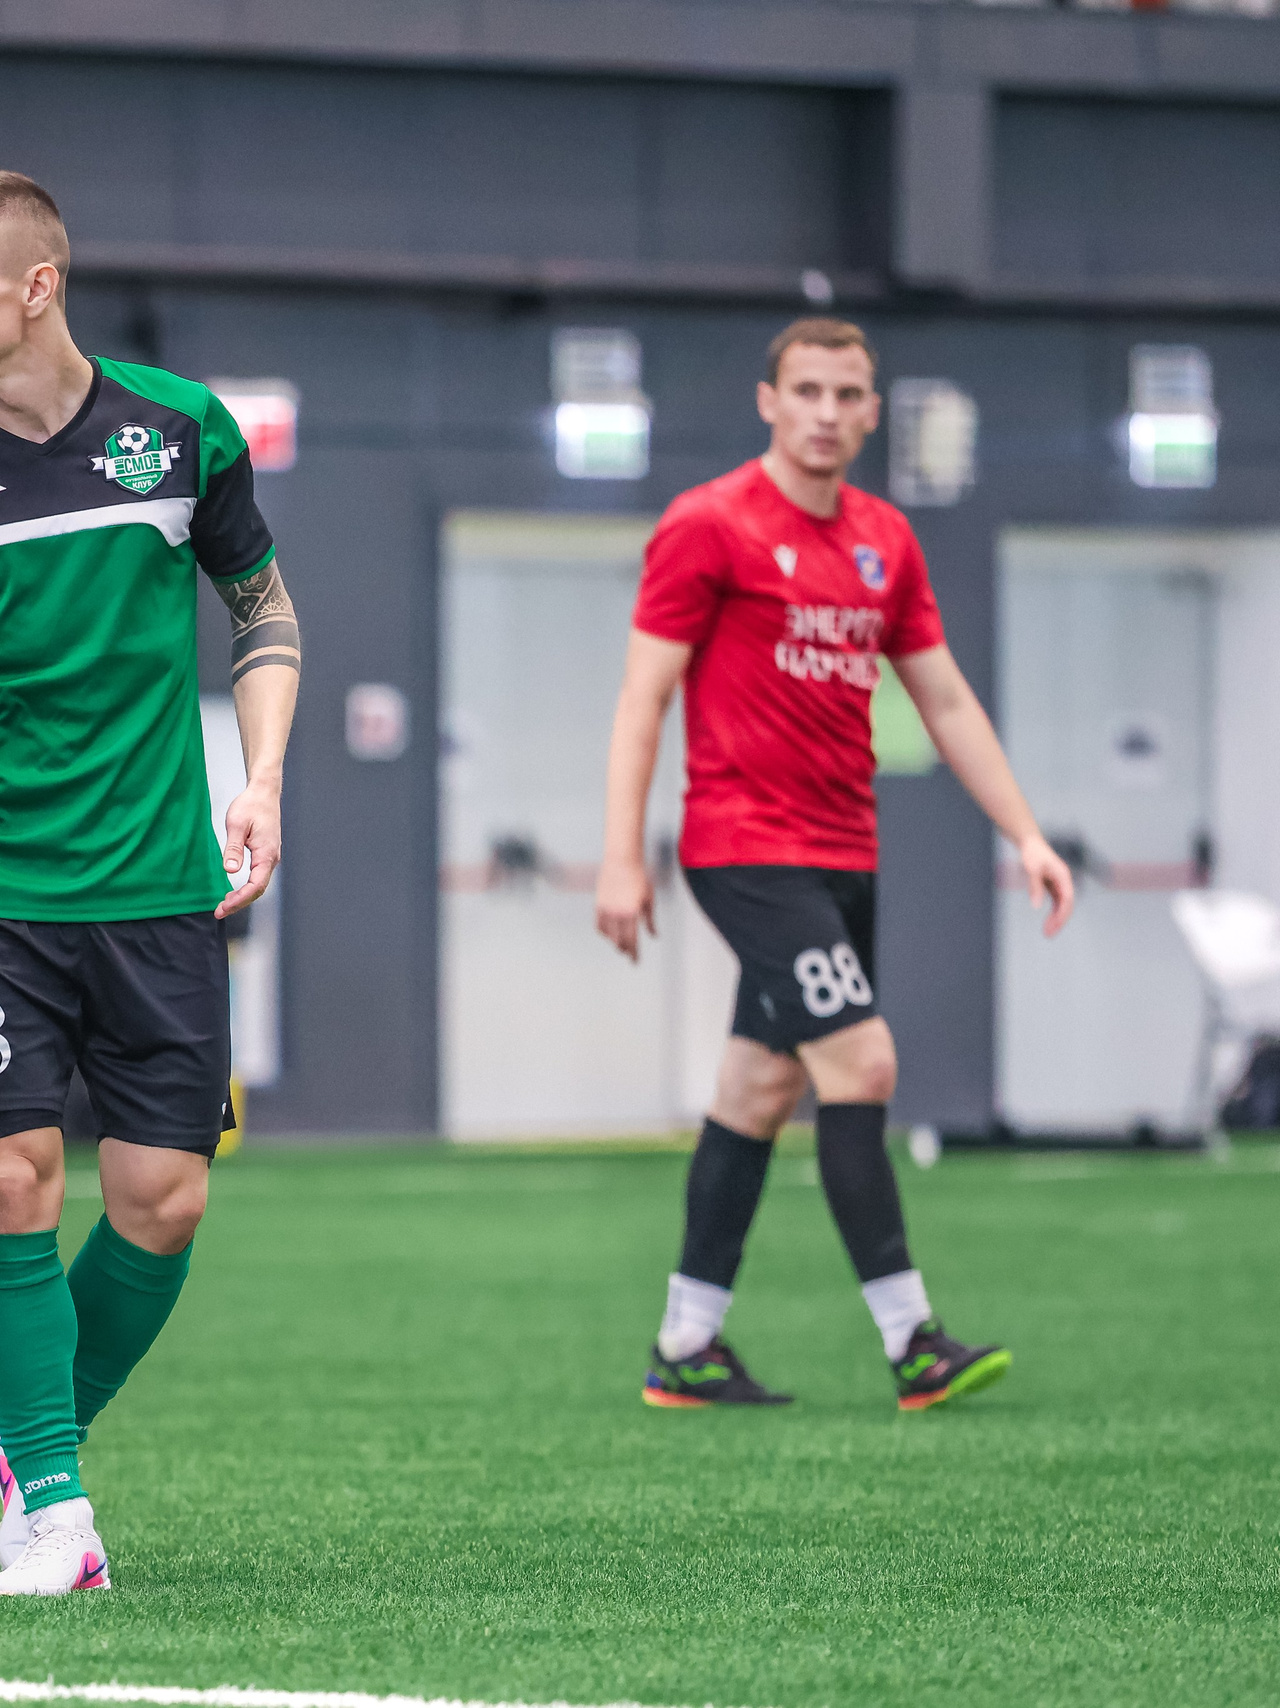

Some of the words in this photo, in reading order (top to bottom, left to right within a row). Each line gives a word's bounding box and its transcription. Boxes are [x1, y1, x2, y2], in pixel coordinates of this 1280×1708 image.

[124, 454, 153, 474] CMD
[132, 479, 153, 489] КЛУБ
[793, 942, 873, 1018] 88
